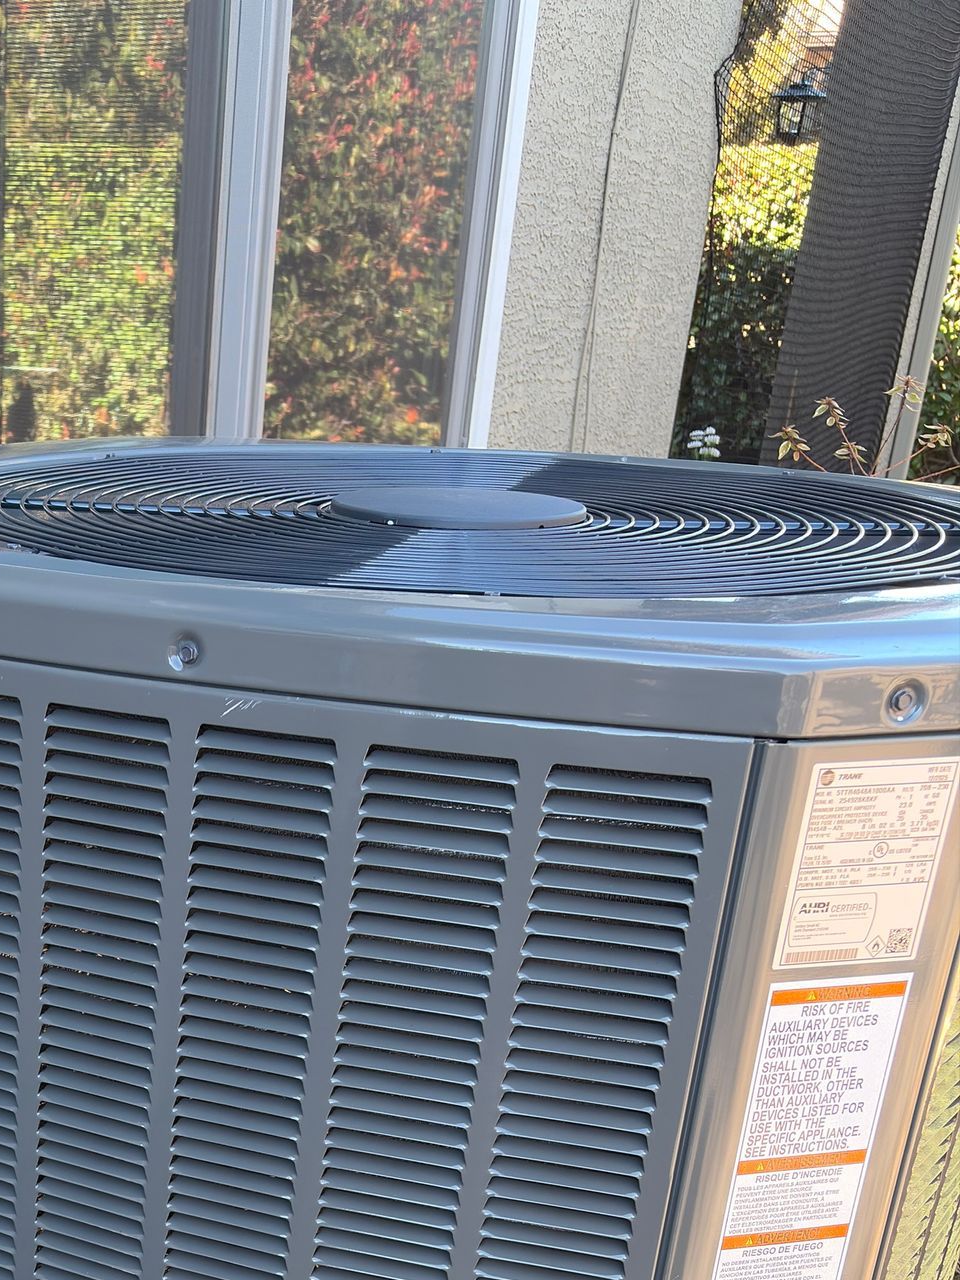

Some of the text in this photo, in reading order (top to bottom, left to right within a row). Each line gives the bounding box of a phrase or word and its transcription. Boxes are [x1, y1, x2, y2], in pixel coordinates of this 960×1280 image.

[831, 903, 869, 913] CERTIFIED
[819, 986, 872, 1000] WARNING
[801, 1001, 871, 1017] RISK OF FIRE
[769, 1015, 879, 1033] AUXILIARY DEVICES
[768, 1030, 849, 1046] WHICH MAY BE
[764, 1040, 869, 1059] IGNITION SOURCES
[762, 1056, 842, 1073] SHALL NOT BE
[759, 1067, 857, 1085] INSTALLED IN THE
[826, 1078, 864, 1092] OTHER
[755, 1091, 845, 1110] THAN AUXILIARY
[752, 1102, 865, 1122] DEVICES LISTED FOR
[750, 1117, 826, 1134] USE WITH THE
[747, 1126, 861, 1146] SPECIFIC APPLIANCE.
[744, 1139, 849, 1158] SEE INSTRUCTIONS.
[755, 1167, 844, 1183] RISQUE D'INCENDIE
[742, 1242, 824, 1257] RIESGO DE FUEGO
